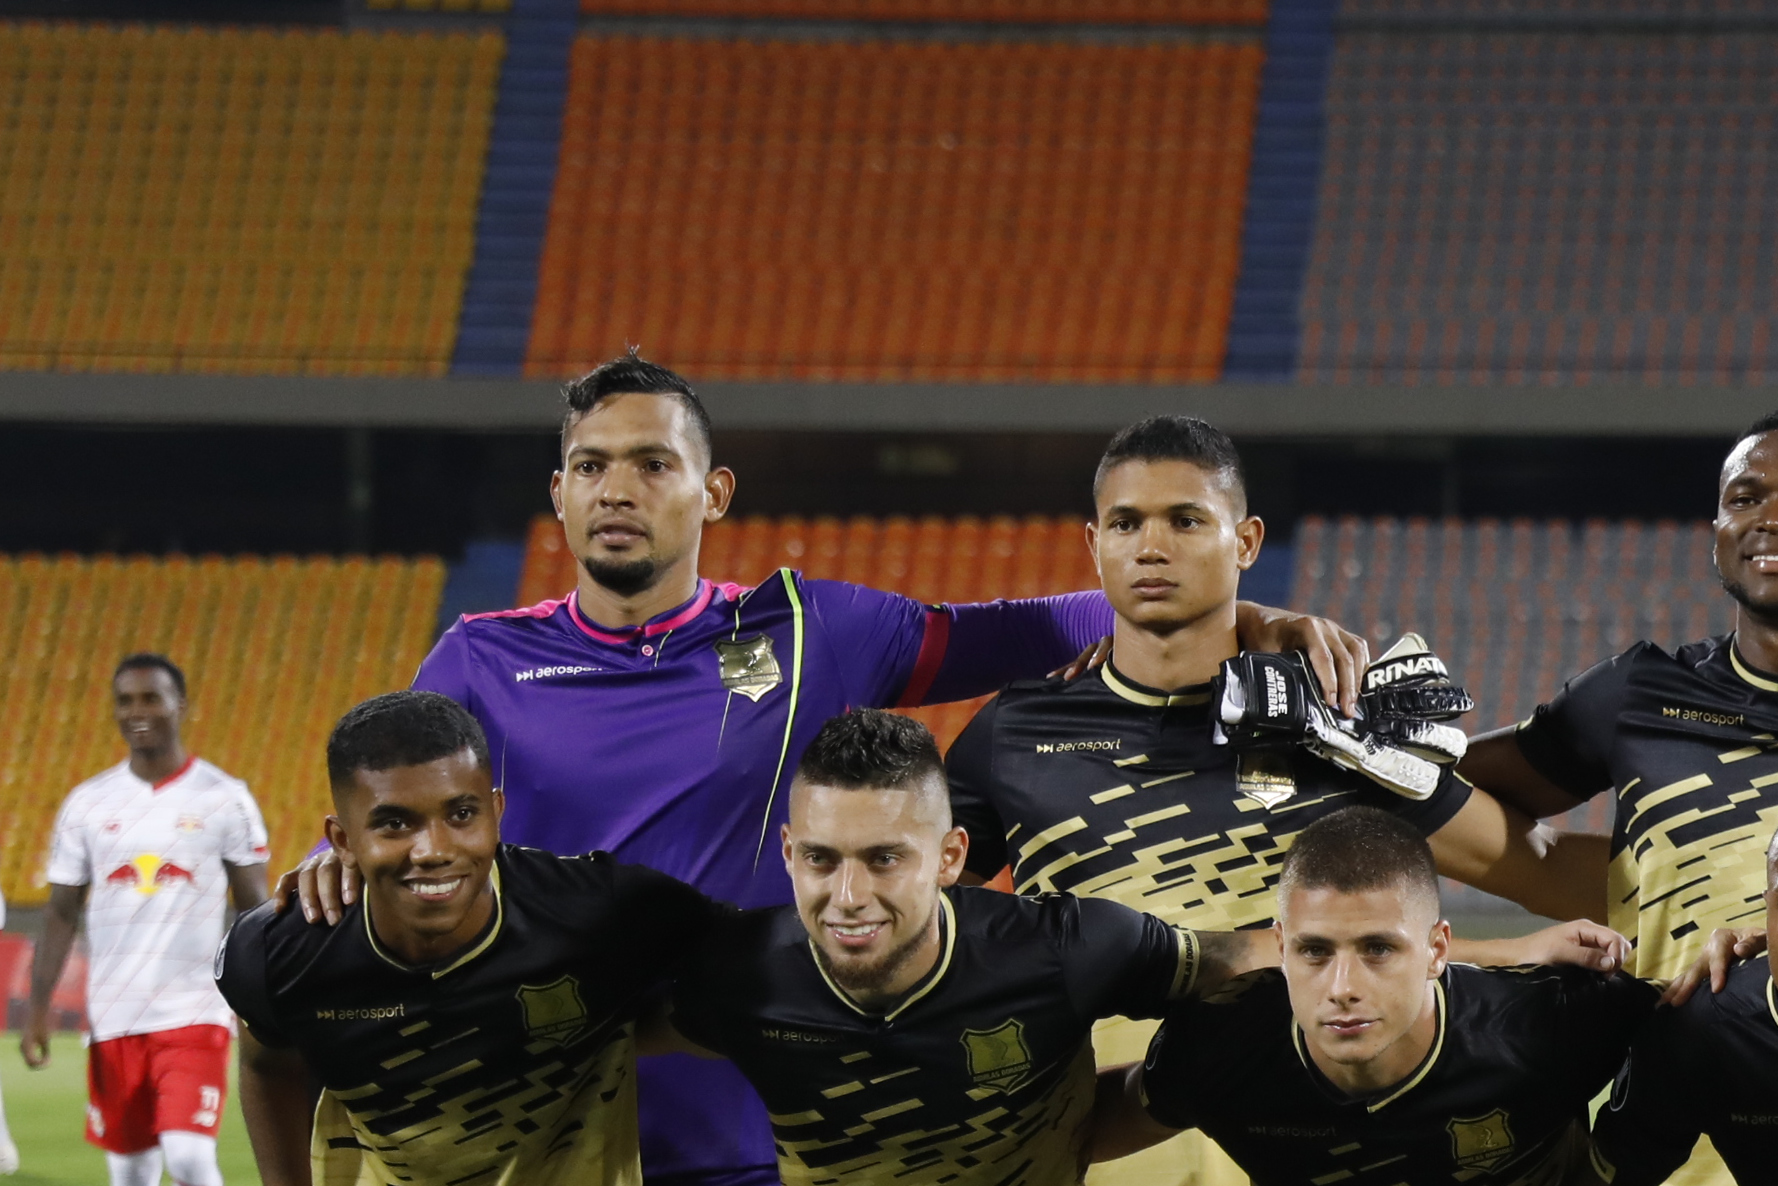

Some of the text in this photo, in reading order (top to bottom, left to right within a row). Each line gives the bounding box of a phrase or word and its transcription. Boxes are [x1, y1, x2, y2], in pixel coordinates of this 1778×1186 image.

[1264, 666, 1278, 718] CONTRERAS
[1275, 670, 1288, 715] JOSE
[1681, 708, 1745, 729] aerosport
[1055, 736, 1121, 754] aerosport
[338, 1003, 405, 1022] aerosport
